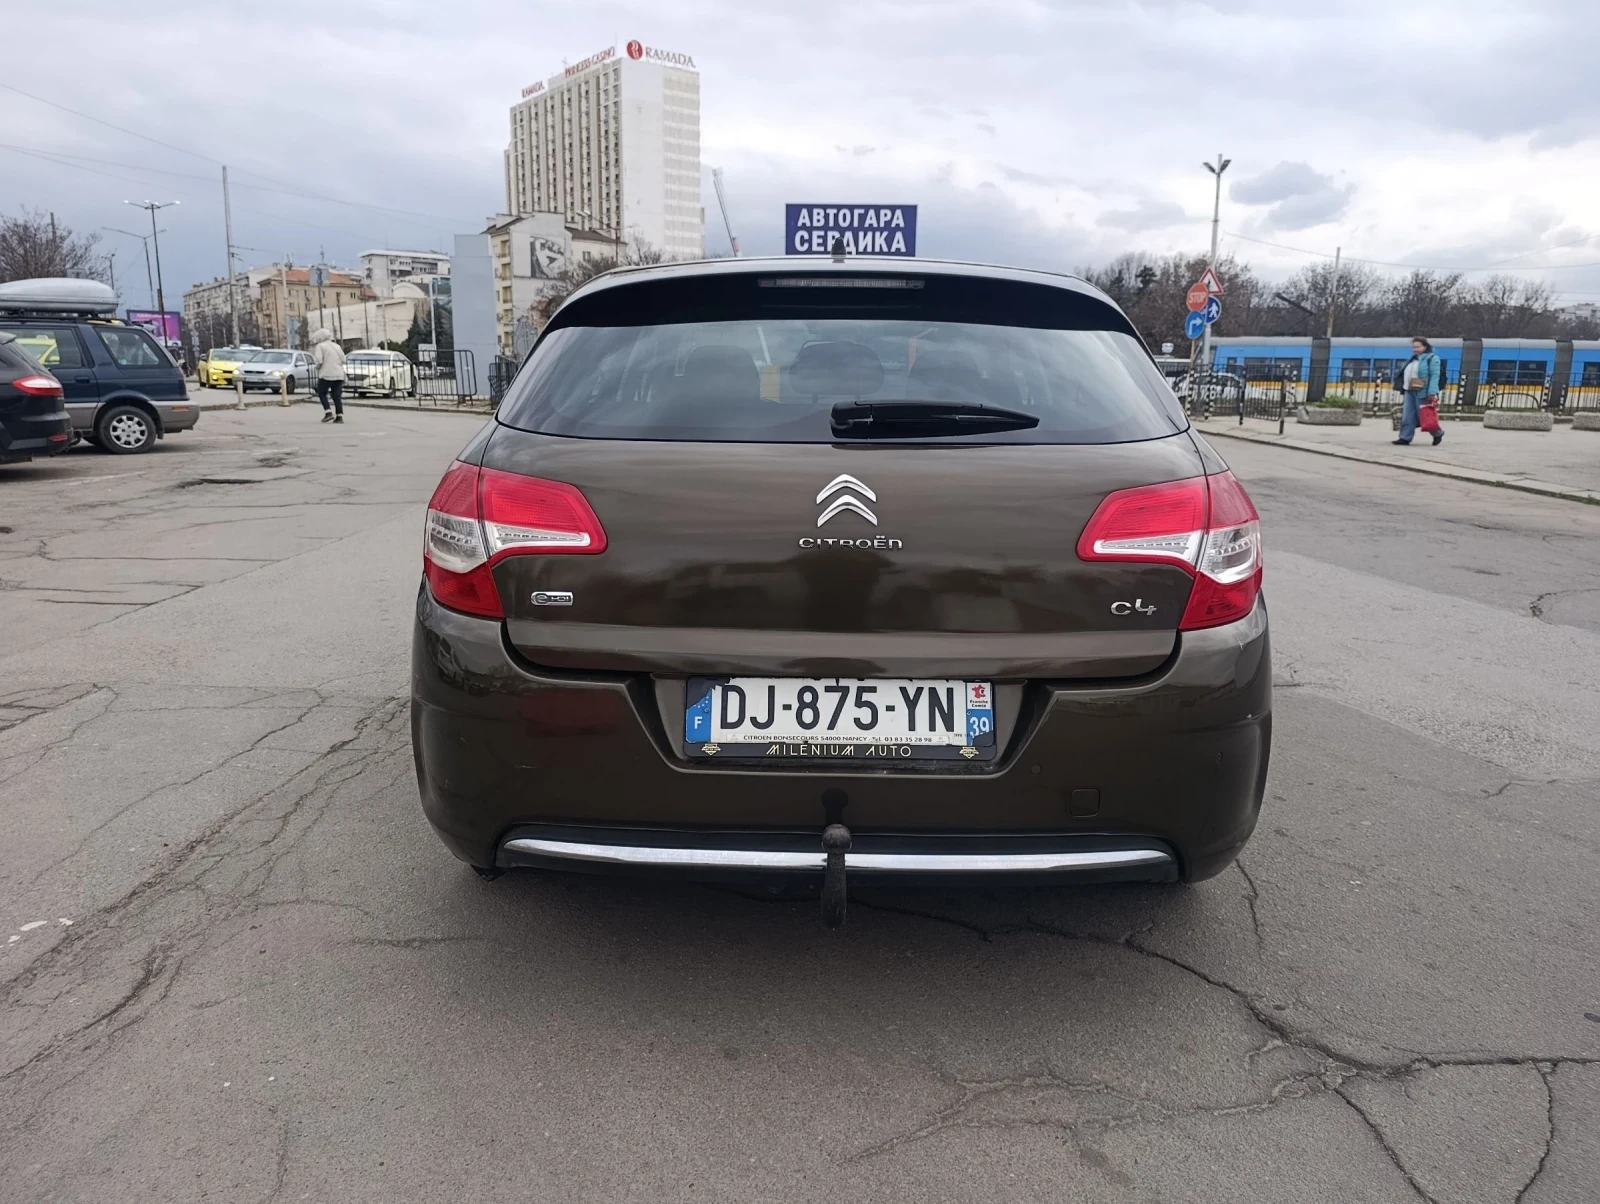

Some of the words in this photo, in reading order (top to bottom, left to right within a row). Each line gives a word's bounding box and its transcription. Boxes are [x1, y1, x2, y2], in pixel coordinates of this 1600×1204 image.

[645, 46, 695, 68] RAMADA
[797, 208, 905, 228] АВТОГАРА
[1188, 291, 1207, 304] STOP
[1110, 598, 1157, 616] C4
[720, 684, 955, 733] DJ-875-YN
[694, 715, 703, 730] F
[969, 716, 990, 738] 39
[773, 734, 819, 742] BONSECOURS
[766, 744, 854, 756] MILENIUM
[865, 745, 912, 757] AUTO
